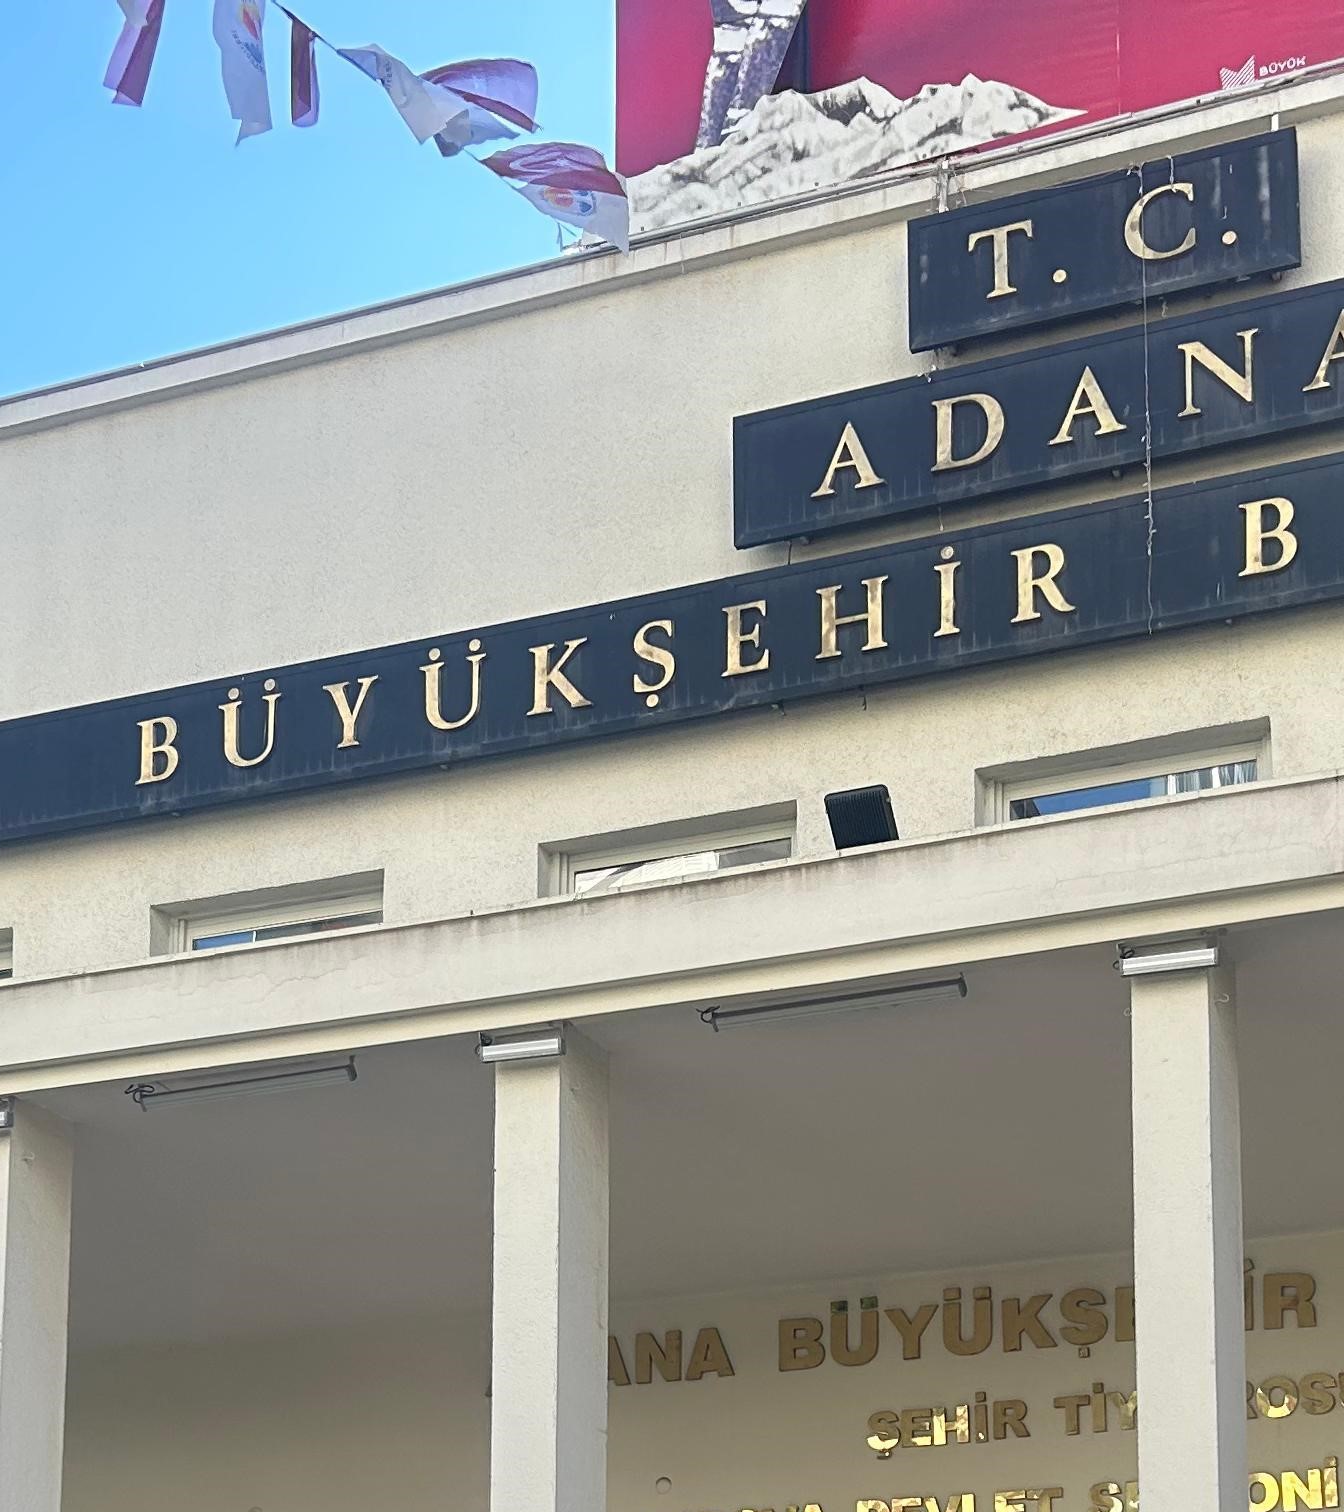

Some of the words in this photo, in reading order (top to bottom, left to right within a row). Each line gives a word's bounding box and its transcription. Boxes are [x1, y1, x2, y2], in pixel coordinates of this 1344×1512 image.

[134, 542, 1075, 786] BÜYÜKŞEHİR
[778, 1257, 1318, 1373] BÜYÜKŞR
[866, 1391, 1030, 1460] ŞEHİR
